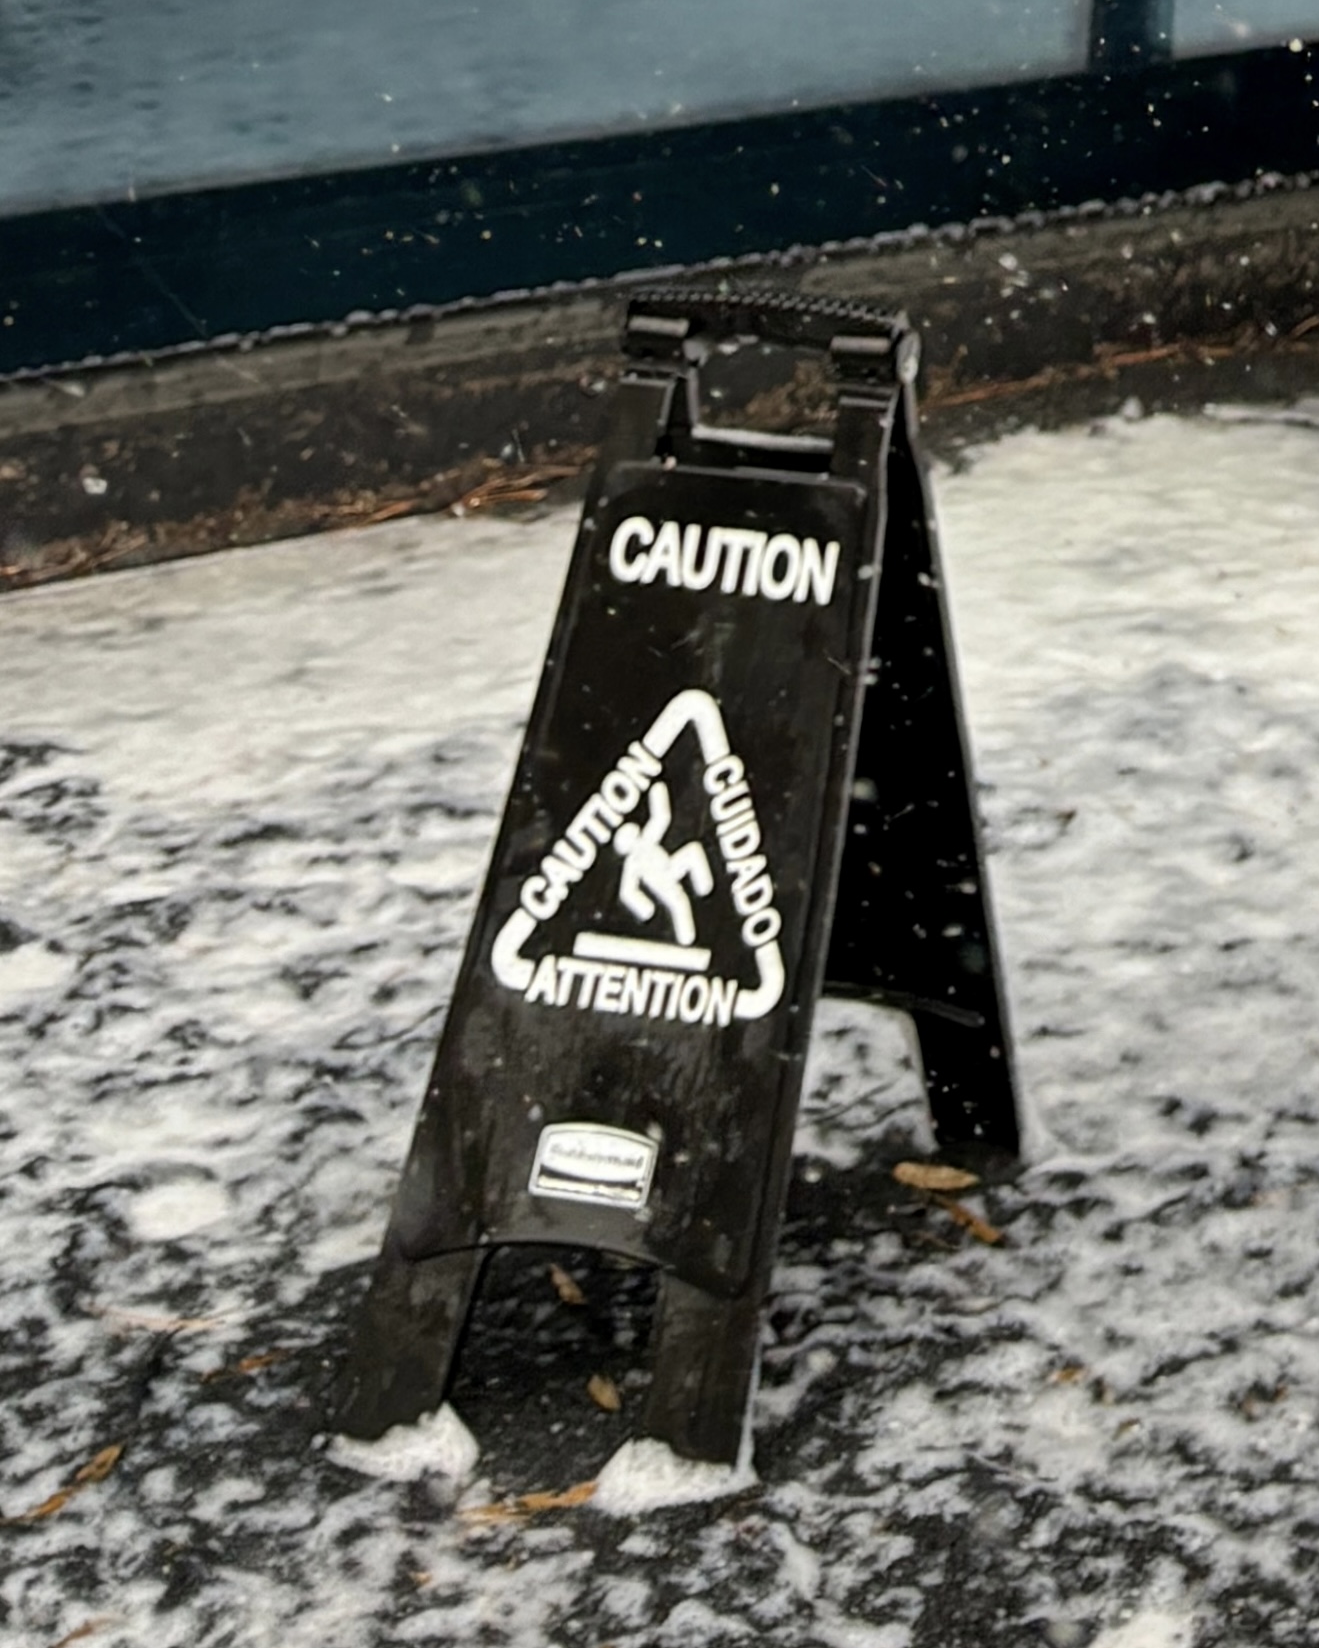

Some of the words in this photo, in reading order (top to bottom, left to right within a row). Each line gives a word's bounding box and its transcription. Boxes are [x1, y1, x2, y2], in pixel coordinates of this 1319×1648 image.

[609, 515, 841, 606] CAUTION
[519, 741, 662, 920] CAUTION
[703, 755, 782, 947] CUIDADO
[523, 954, 739, 1027] ATTENTION
